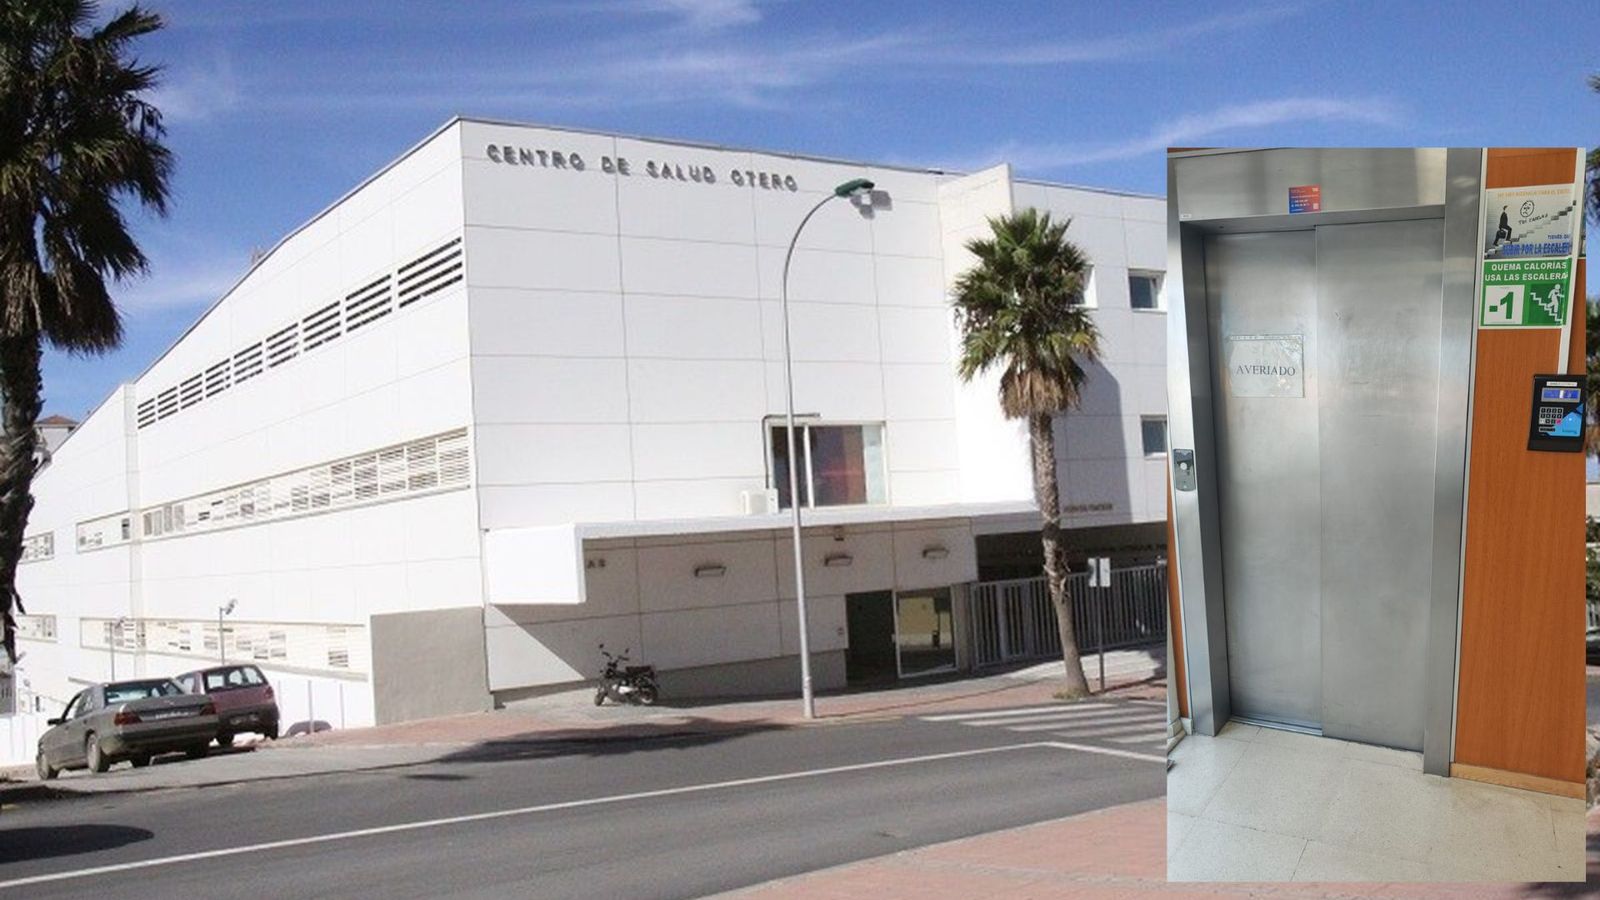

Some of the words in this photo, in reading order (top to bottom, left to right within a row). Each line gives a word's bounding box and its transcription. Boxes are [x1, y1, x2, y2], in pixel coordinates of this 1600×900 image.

[487, 144, 584, 172] CENTRO
[600, 156, 630, 176] DE
[645, 160, 717, 184] SALUD
[730, 169, 799, 192] OTERO
[1491, 263, 1521, 271] QUEMA
[1504, 273, 1520, 281] LAS
[1522, 272, 1568, 280] ESCALERA
[1236, 365, 1296, 376] AVERIADO
